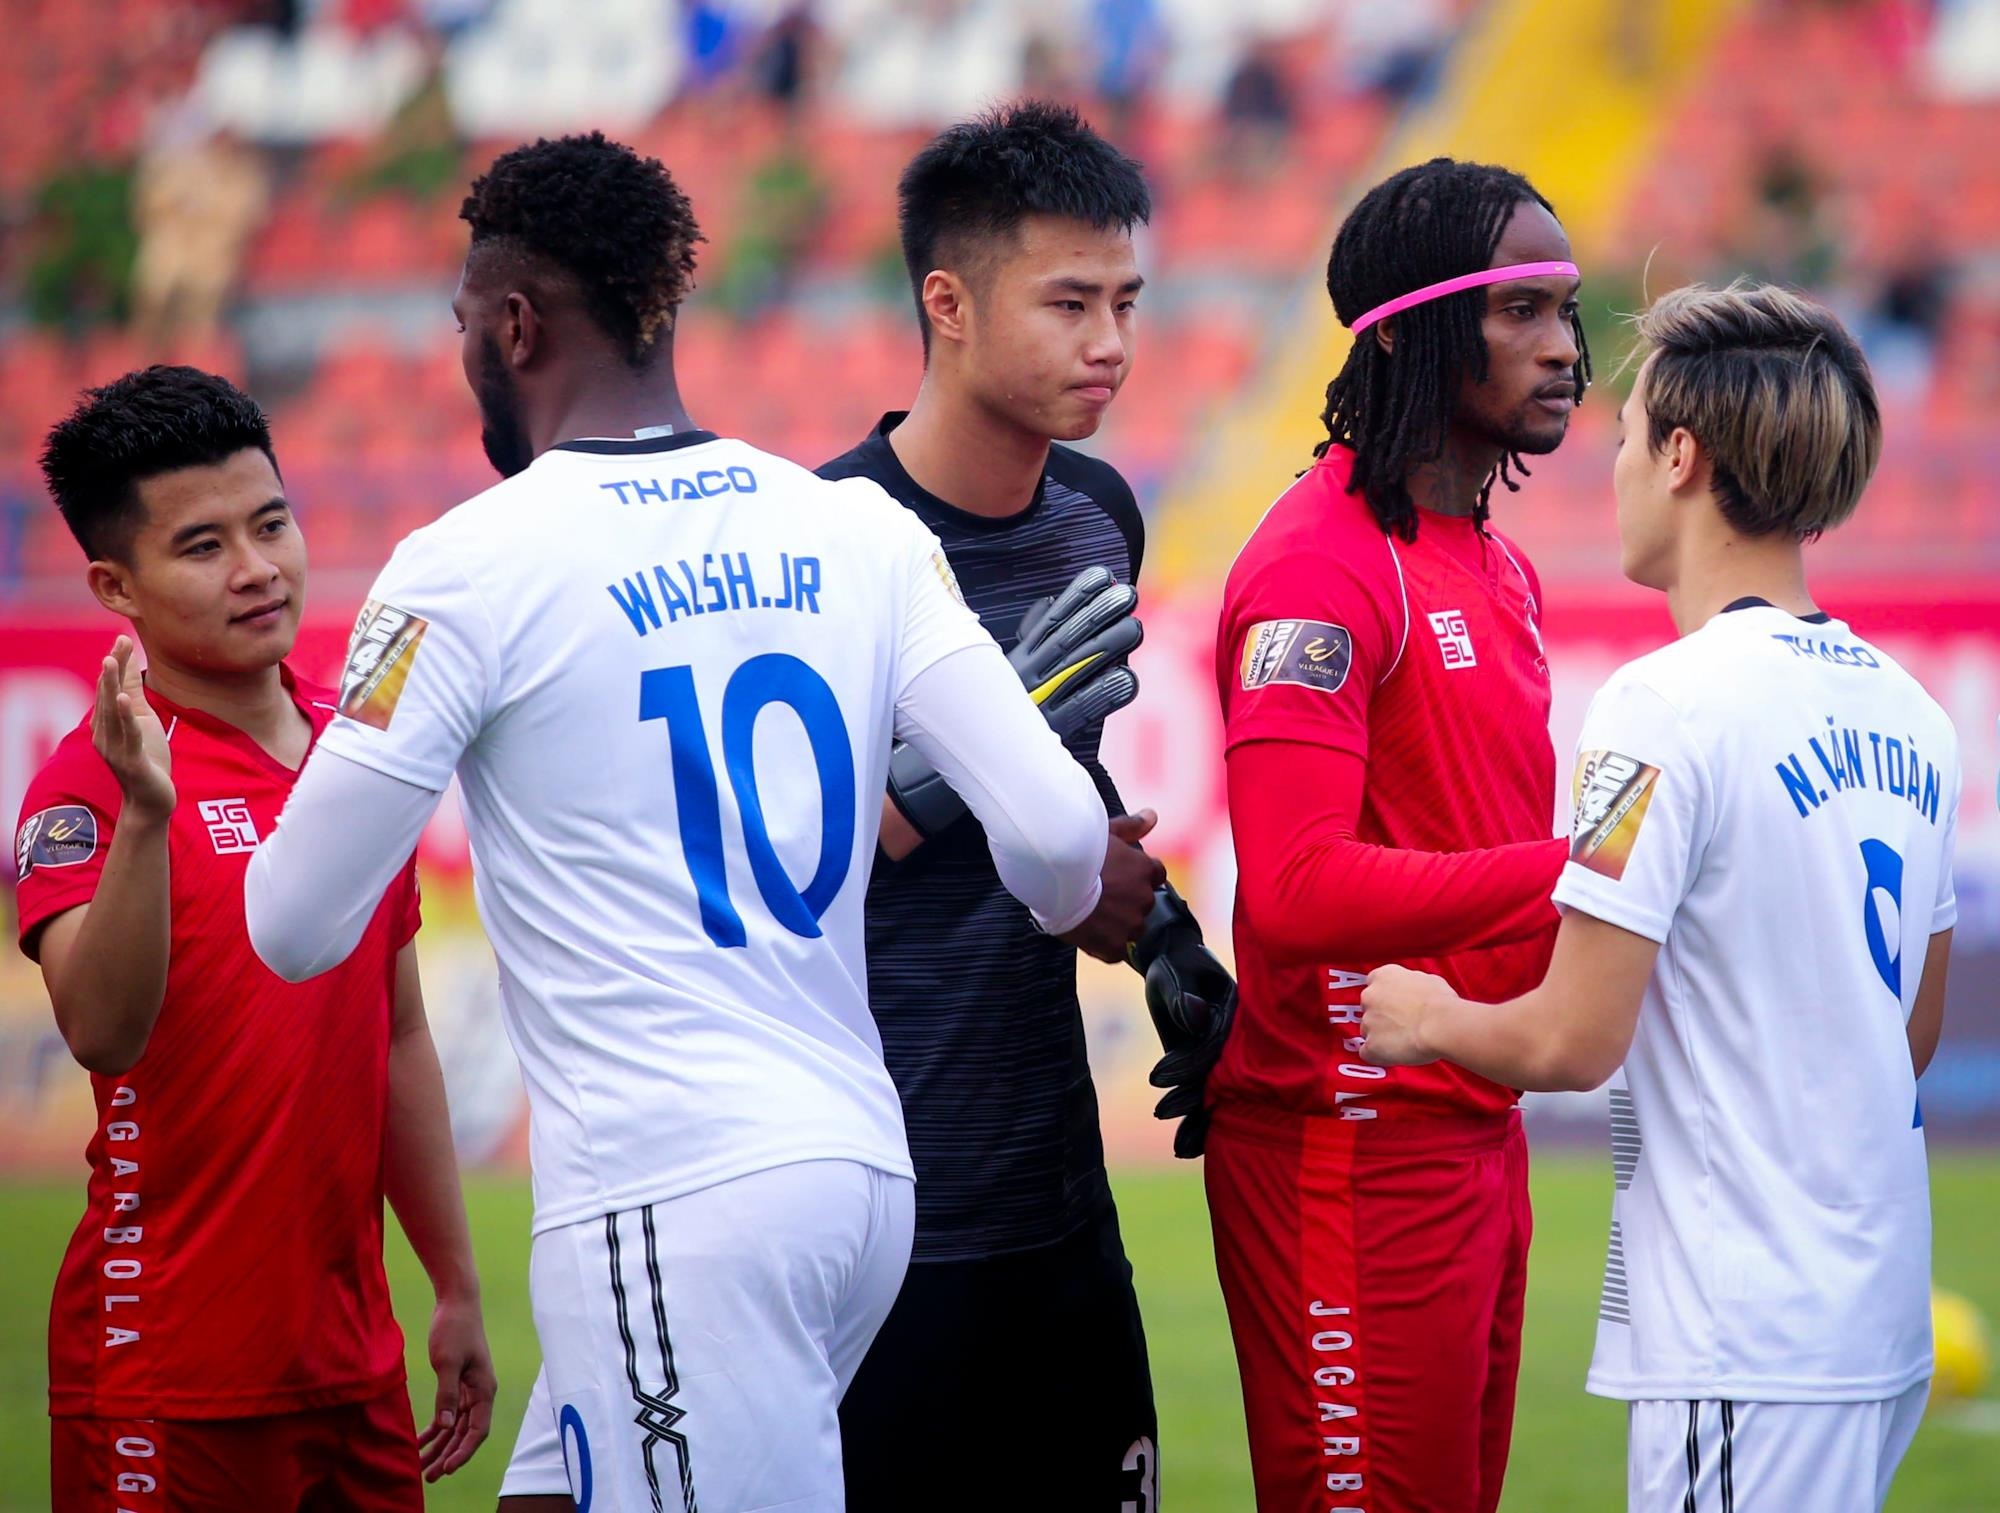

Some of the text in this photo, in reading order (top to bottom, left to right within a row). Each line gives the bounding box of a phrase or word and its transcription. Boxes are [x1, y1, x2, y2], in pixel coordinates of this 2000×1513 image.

[599, 466, 757, 504] THACO
[607, 553, 821, 637] WALSH.JR
[1248, 629, 1272, 681] wake-up
[1770, 634, 1880, 668] THACO
[639, 653, 855, 947] 10
[1869, 733, 1940, 827] TOÀN
[1309, 1300, 1366, 1513] JOGARB
